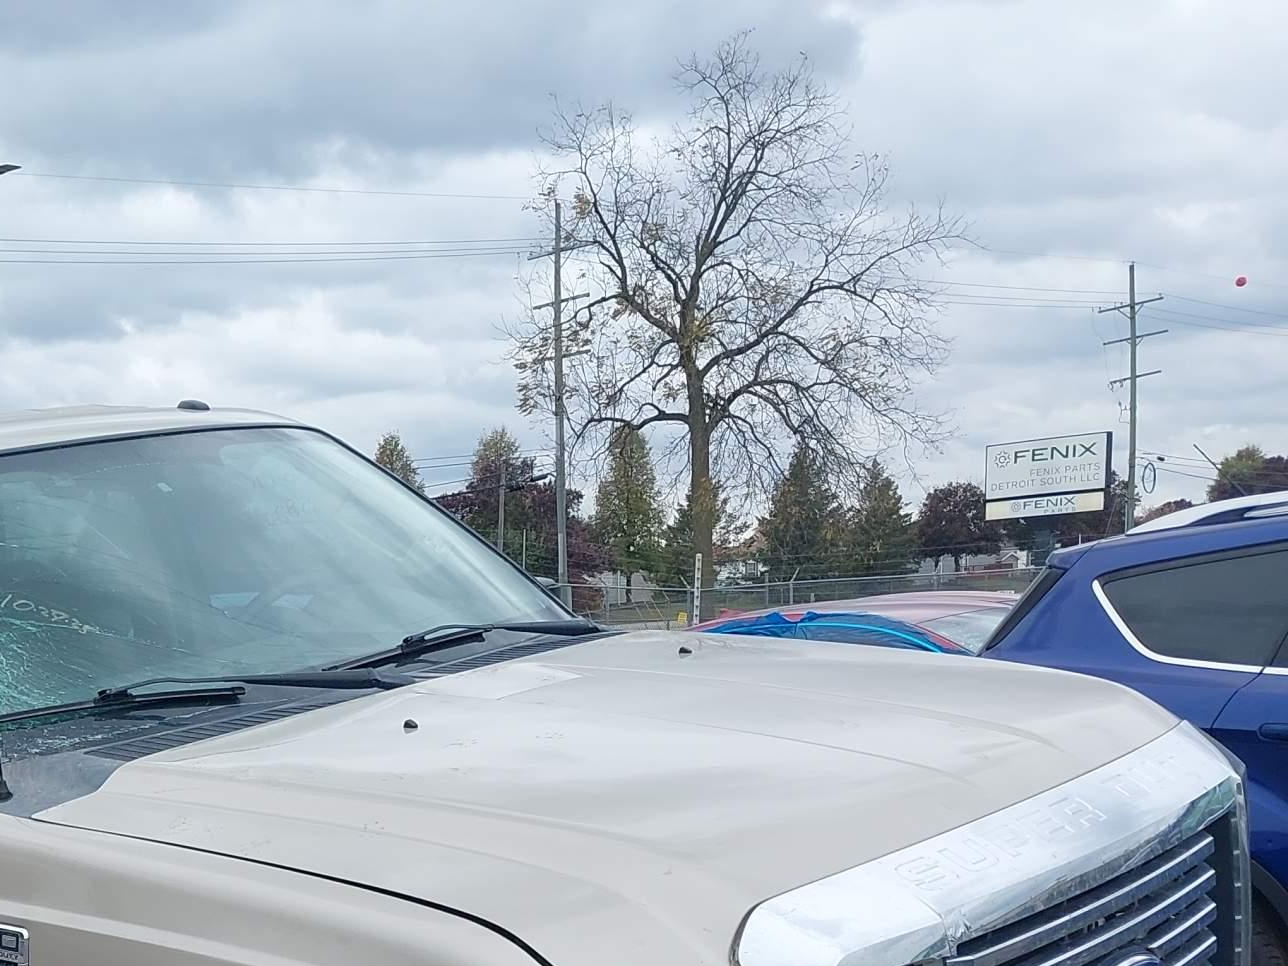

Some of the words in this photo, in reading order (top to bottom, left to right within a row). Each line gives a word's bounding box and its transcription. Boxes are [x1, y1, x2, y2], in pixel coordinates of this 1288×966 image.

[1014, 442, 1097, 464] FENIX
[1029, 467, 1061, 477] FENIX
[1064, 463, 1101, 473] PARTS
[990, 479, 1037, 491] DETROIT
[1039, 475, 1077, 486] SOUTH
[1080, 473, 1101, 482] LLC
[1023, 496, 1076, 510] FENIX
